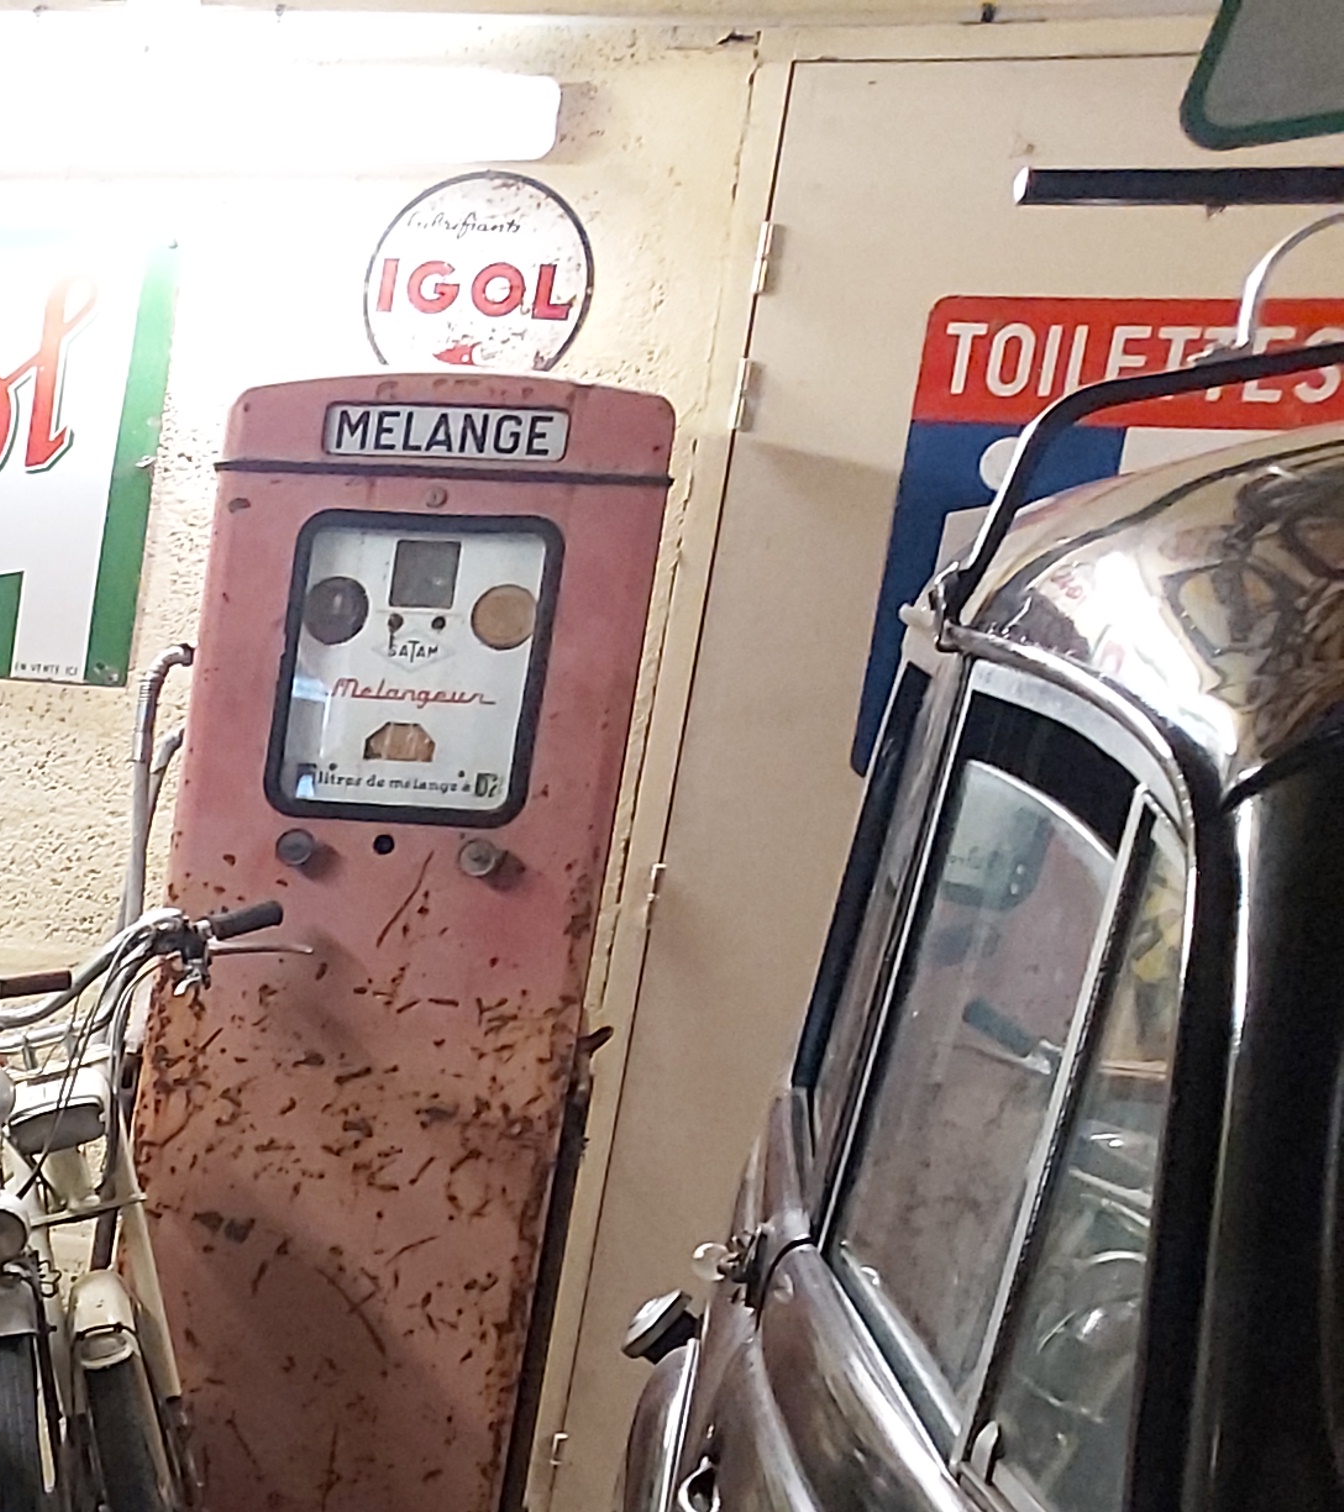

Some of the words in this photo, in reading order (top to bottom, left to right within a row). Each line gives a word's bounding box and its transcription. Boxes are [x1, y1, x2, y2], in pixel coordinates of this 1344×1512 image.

[376, 258, 576, 321] IGOL
[335, 409, 554, 456] MELANGE
[366, 774, 385, 787] de
